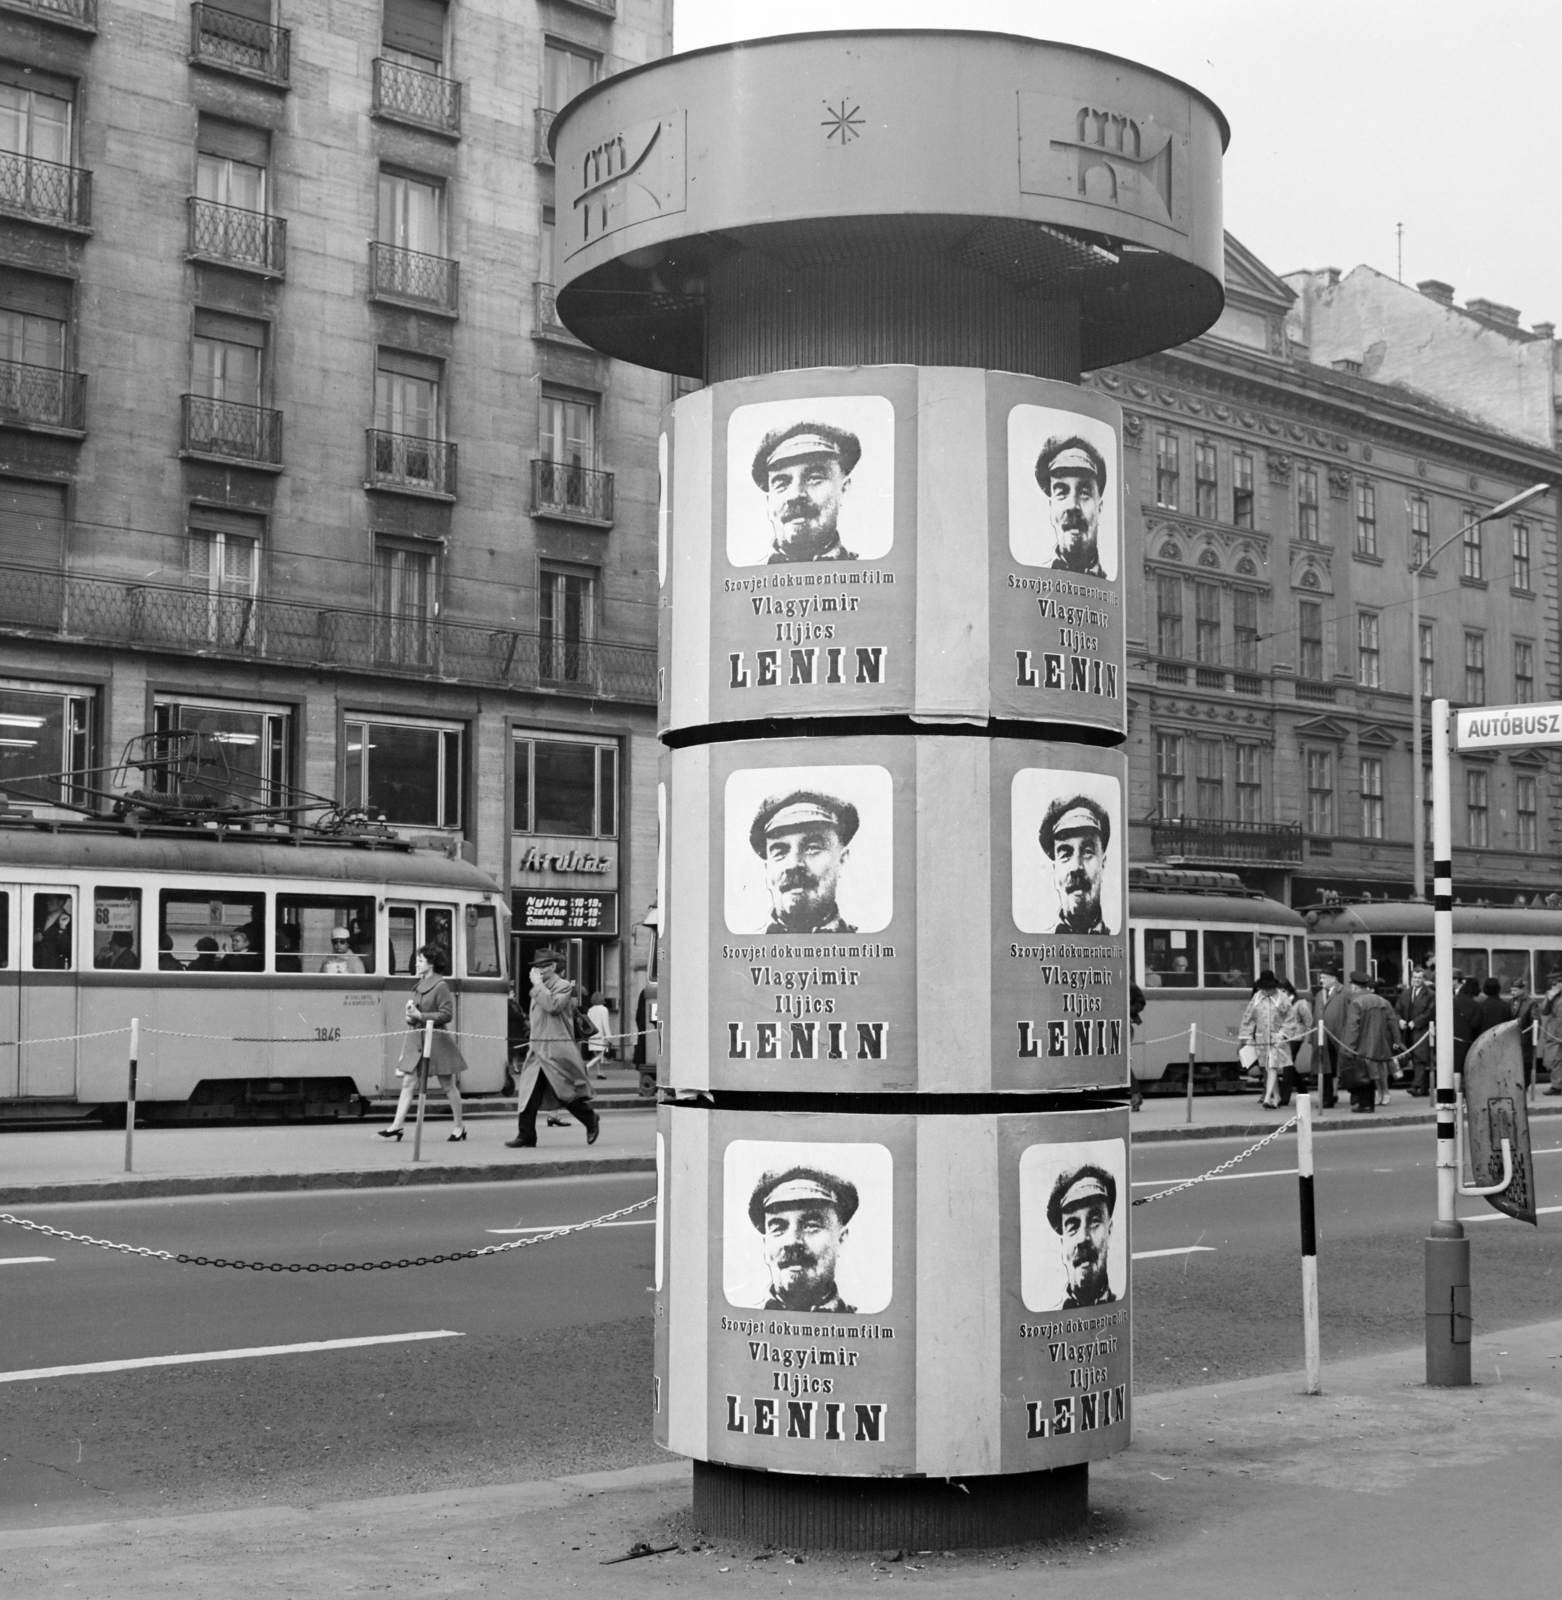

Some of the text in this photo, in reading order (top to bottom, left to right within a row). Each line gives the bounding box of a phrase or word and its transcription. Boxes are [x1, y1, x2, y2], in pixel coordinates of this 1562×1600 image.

[724, 570, 896, 593] Szovjet dokumentumfilm
[1007, 573, 1052, 594] Szovjet
[751, 593, 860, 618] Vlagyimir
[1036, 597, 1109, 629] Vlagyimir
[775, 621, 836, 646] Iljics
[1059, 627, 1098, 654] Iljics
[729, 646, 887, 689] LENIN
[1015, 649, 1118, 700] LENIN
[1468, 711, 1560, 738] AUTÓBUSZ
[95, 907, 110, 925] 68
[722, 943, 896, 962] Szovjet dokumentumfilm
[1010, 943, 1056, 962] Szovjet
[750, 966, 860, 991] Vlagyimir
[1040, 965, 1112, 990] Vlagyimir
[775, 994, 836, 1019] Iljics
[1063, 992, 1101, 1018] Iljics
[315, 1027, 341, 1042] 3846
[728, 1021, 889, 1060] LENIN
[1016, 1019, 1122, 1059] LENIN
[721, 1315, 896, 1339] Szovjet dokumentumfilm
[1019, 1320, 1064, 1340] Szovjet
[748, 1340, 860, 1369] Vlagyimir
[1047, 1334, 1118, 1363] Vlagyimir
[773, 1371, 834, 1398] Iljics
[1069, 1366, 1108, 1392] Iljics
[726, 1393, 887, 1442] LENIN
[1026, 1383, 1126, 1440] LENIN
